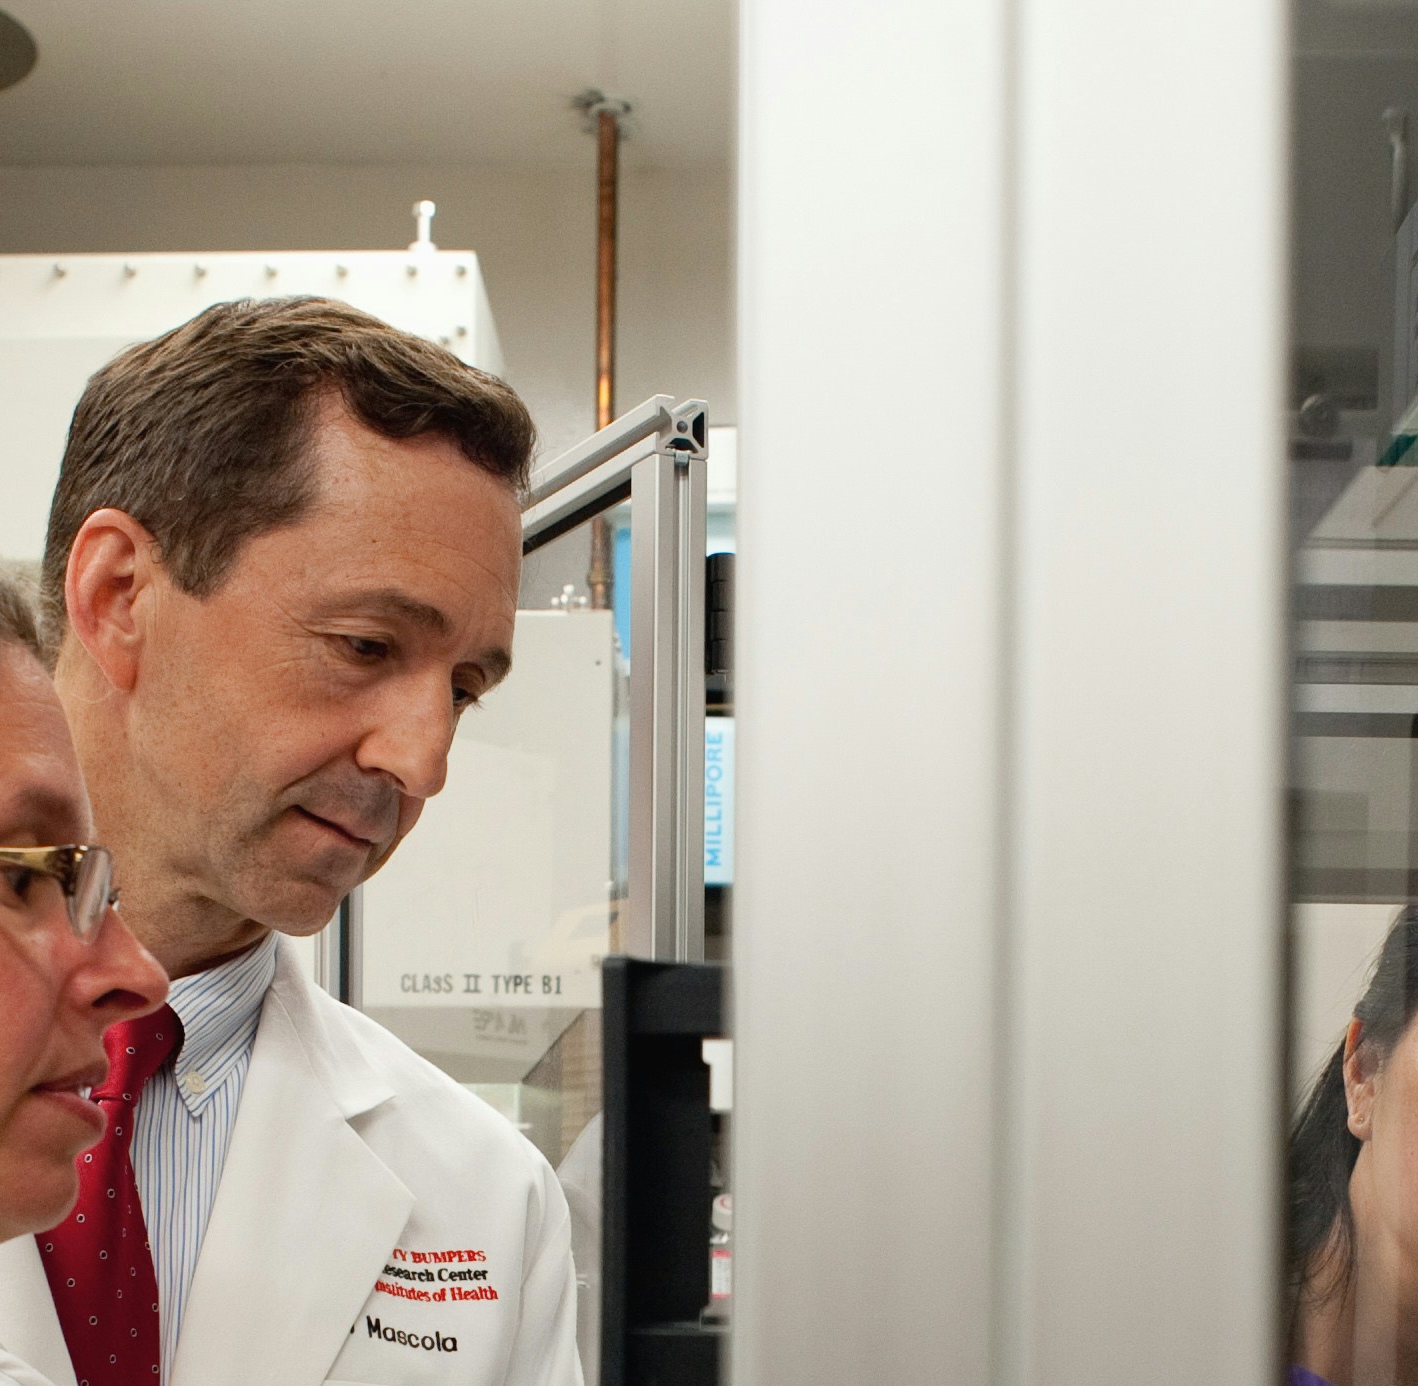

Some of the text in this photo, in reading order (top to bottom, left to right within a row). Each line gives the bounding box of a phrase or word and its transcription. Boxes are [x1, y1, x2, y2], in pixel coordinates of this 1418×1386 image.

[706, 731, 723, 867] MILLIPORE
[400, 973, 562, 995] CLASS II TYPE B1
[410, 1249, 487, 1264] BUMPERS
[382, 1264, 489, 1282] esearch Center
[433, 1287, 448, 1303] of
[450, 1285, 499, 1302] Health
[366, 1315, 458, 1353] Mascola
